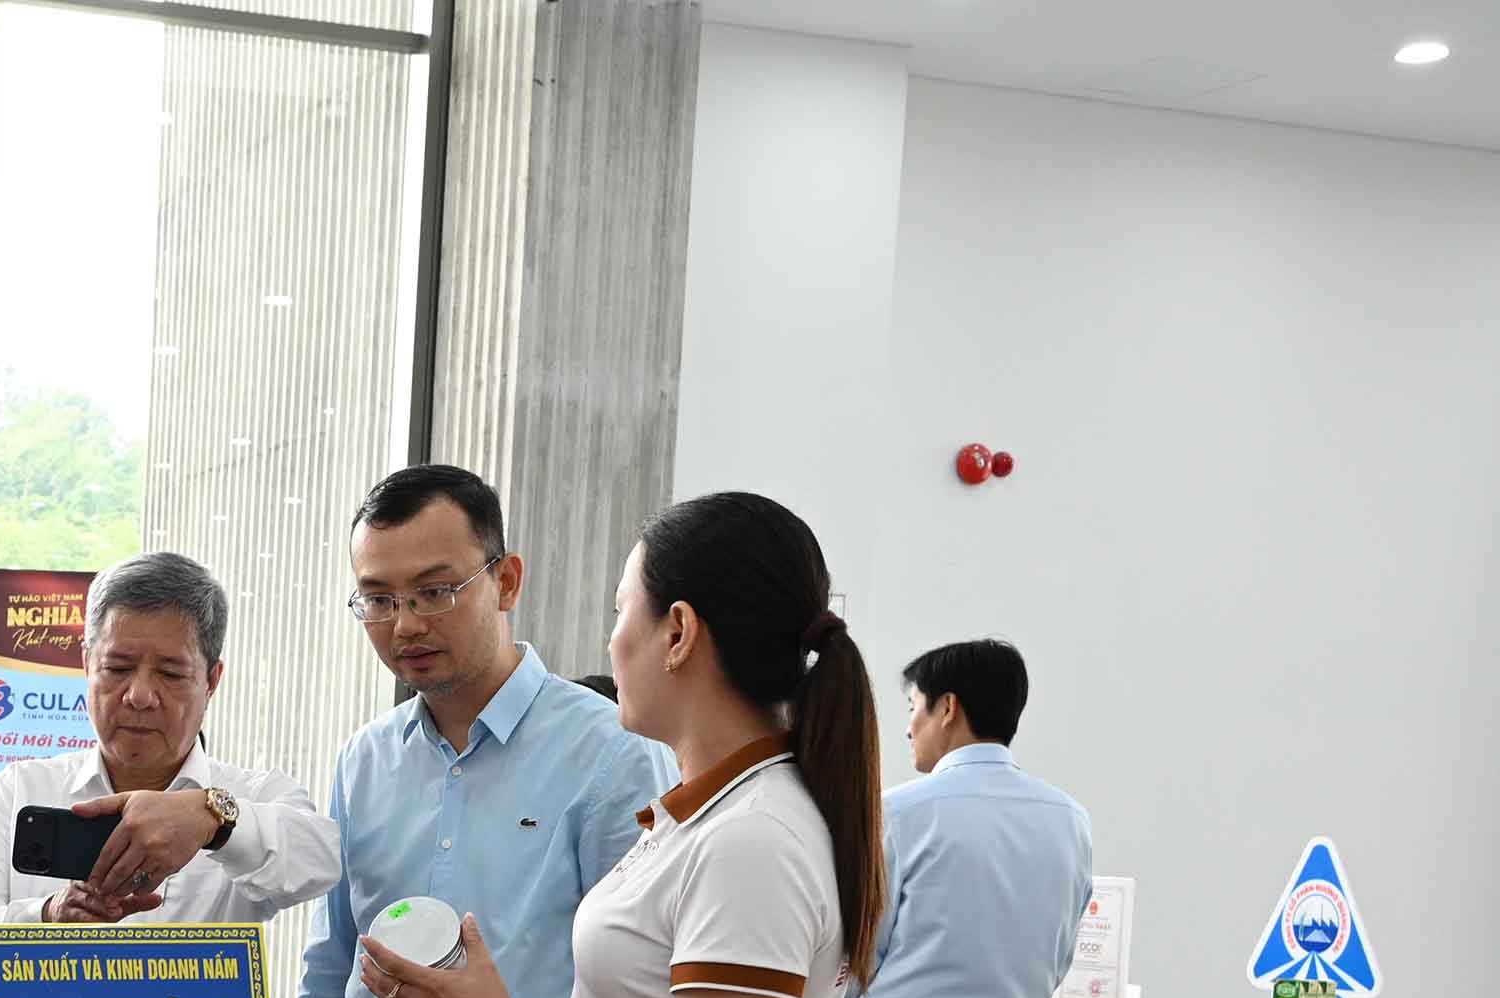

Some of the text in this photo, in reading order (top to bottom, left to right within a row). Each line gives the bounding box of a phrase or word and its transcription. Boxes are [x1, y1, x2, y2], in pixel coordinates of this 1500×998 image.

[7, 602, 84, 627] NGHĨA
[22, 734, 53, 747] Mới
[2, 952, 34, 982] SẢN
[39, 952, 78, 981] XUẤT
[82, 955, 102, 981] VÀ
[107, 957, 144, 981] KINH
[148, 958, 199, 980] DOANH
[204, 952, 239, 980] NẤM
